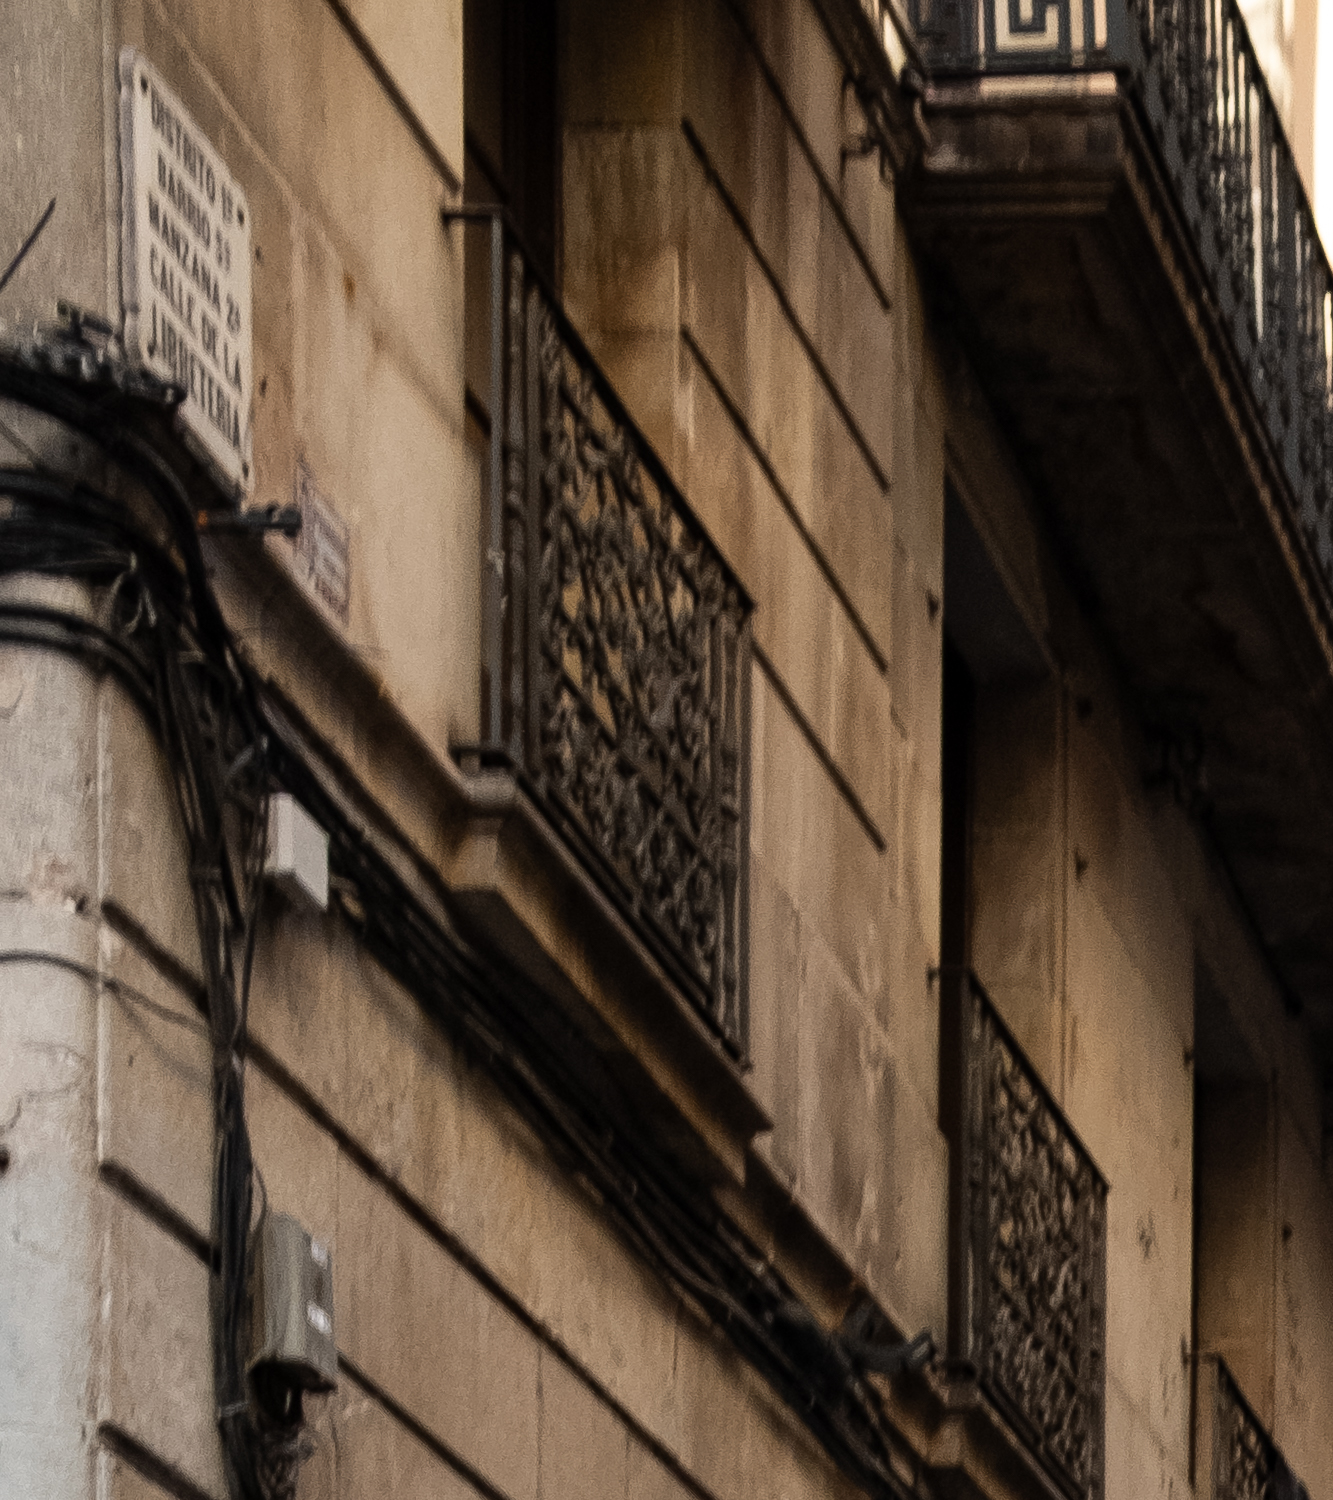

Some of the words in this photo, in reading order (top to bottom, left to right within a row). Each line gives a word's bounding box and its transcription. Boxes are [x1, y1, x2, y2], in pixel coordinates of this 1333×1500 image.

[151, 86, 215, 207] DISTRITO
[157, 152, 211, 250] BARRIO
[149, 194, 221, 318] MANZANA
[151, 245, 197, 340] CALLE
[201, 312, 220, 366] DE
[224, 338, 242, 393] LA
